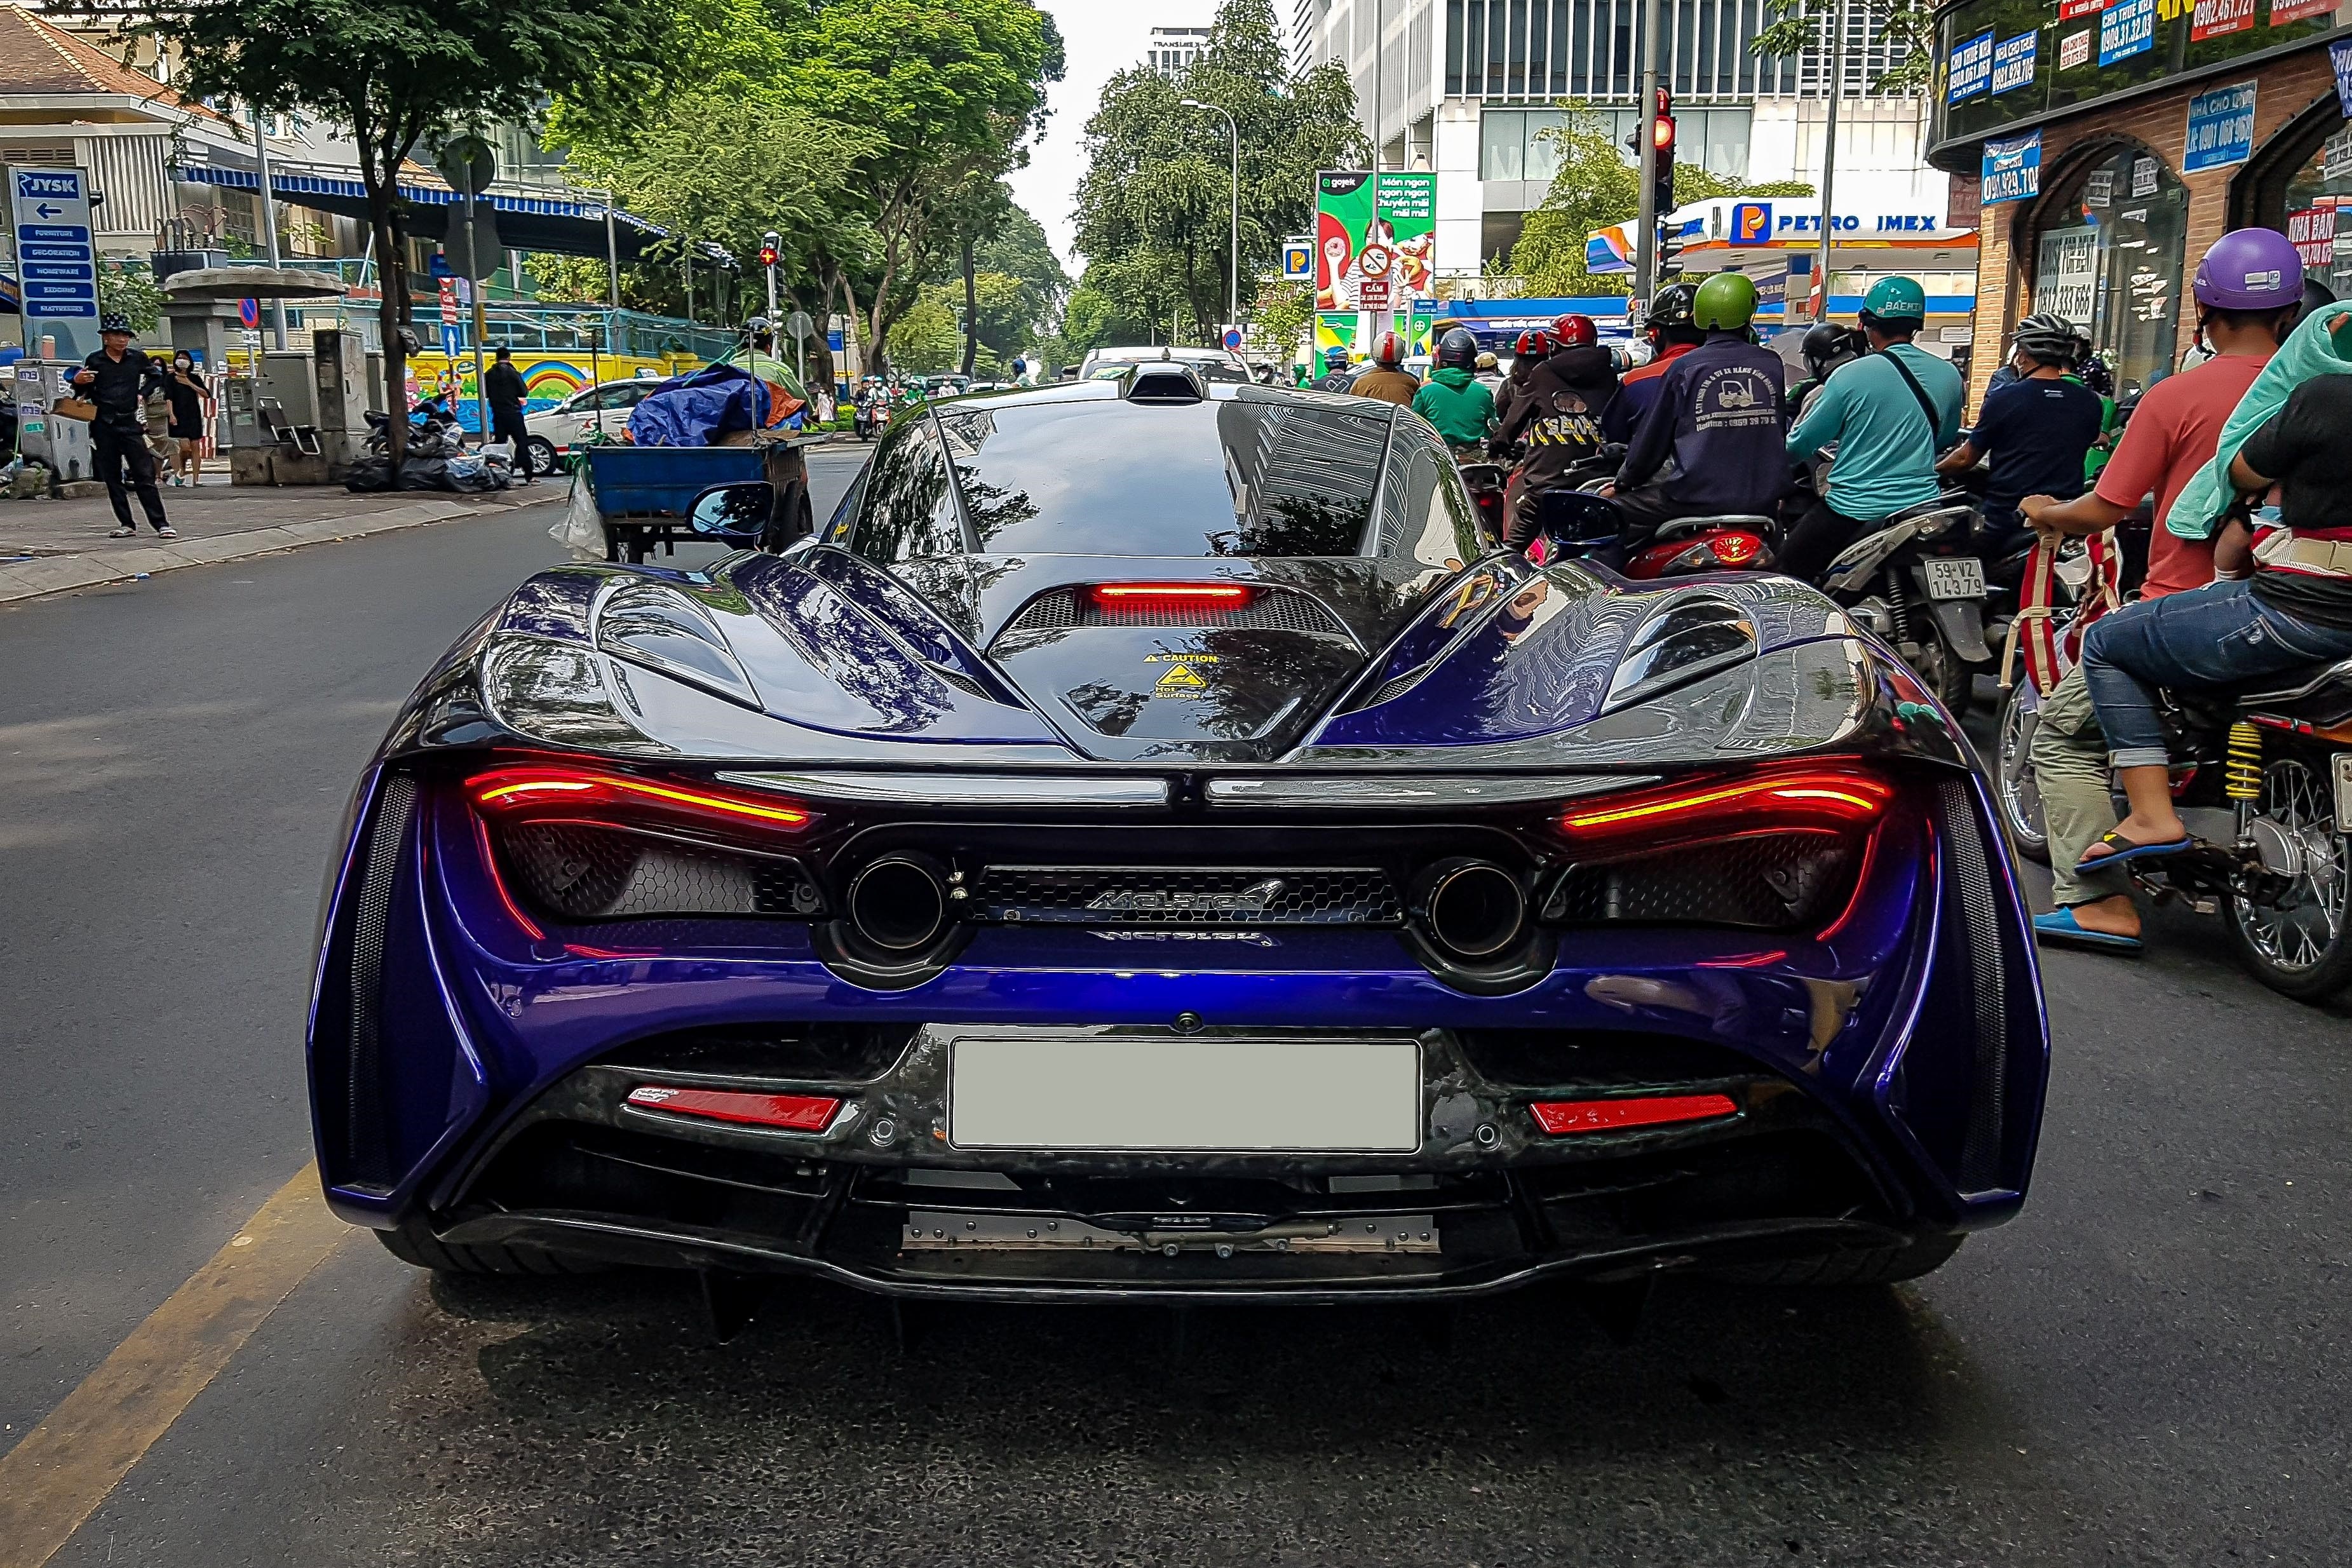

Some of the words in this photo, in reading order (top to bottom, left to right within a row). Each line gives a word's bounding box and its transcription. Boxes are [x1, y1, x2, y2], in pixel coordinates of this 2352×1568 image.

[31, 179, 76, 193] JYSK
[1331, 178, 1356, 187] gojek
[1382, 178, 1403, 186] Món
[1405, 179, 1429, 188] ngon
[1378, 190, 1403, 198] ngon
[1404, 190, 1429, 198] ngon
[1877, 215, 1936, 232] IMEX
[1163, 654, 1219, 663] CAUTION
